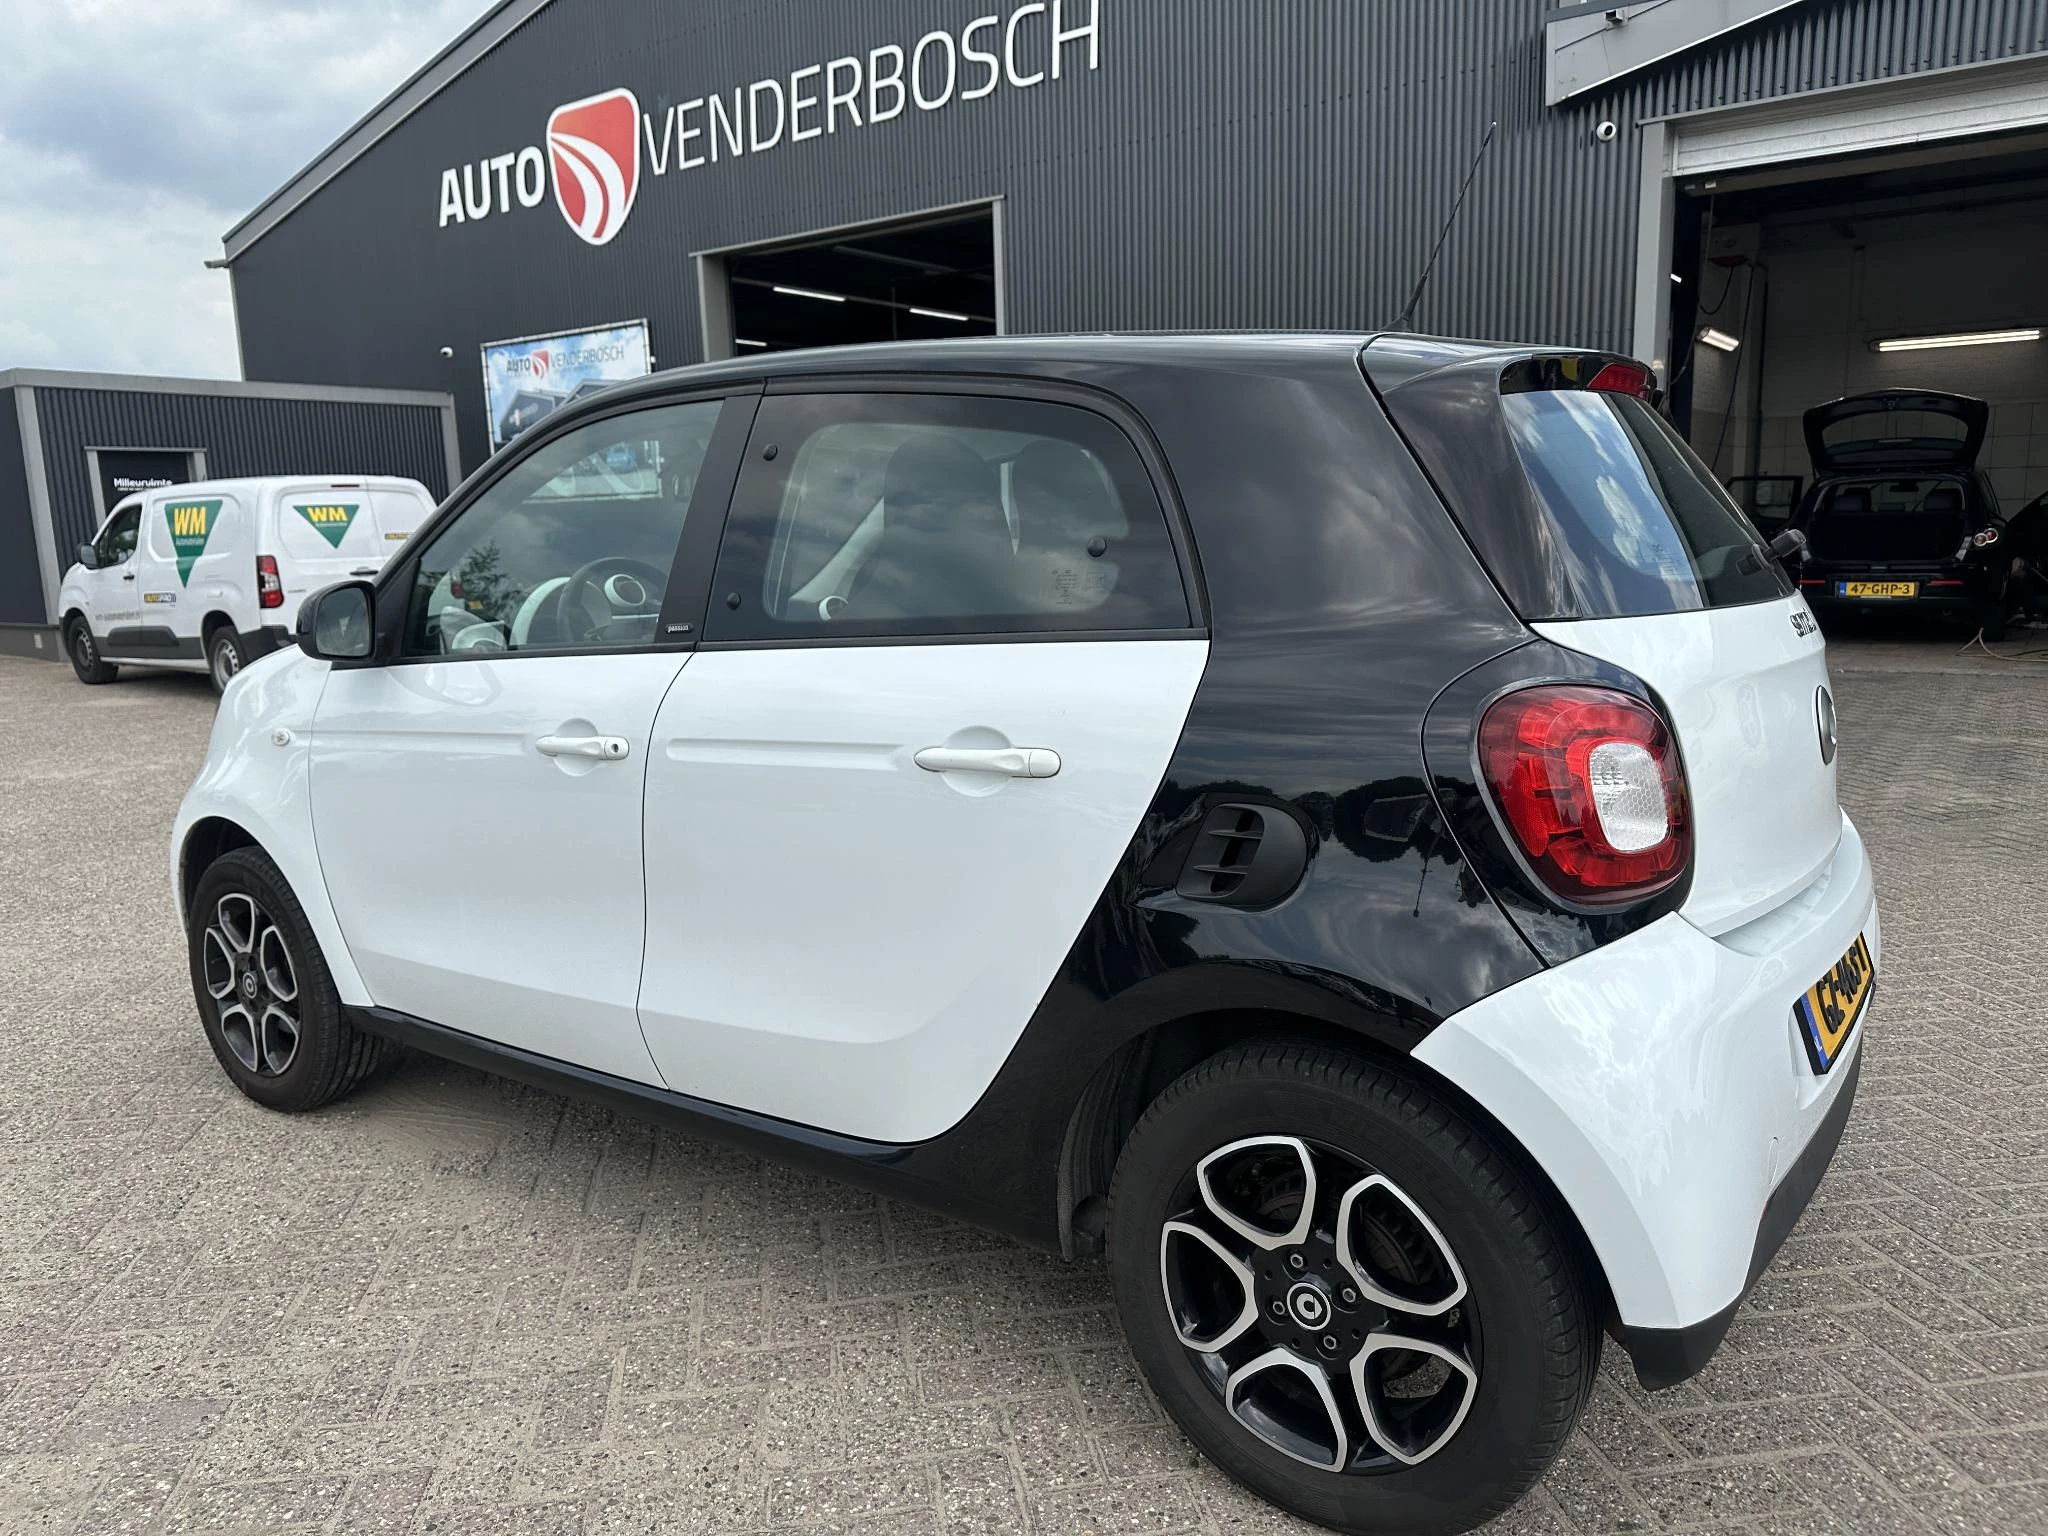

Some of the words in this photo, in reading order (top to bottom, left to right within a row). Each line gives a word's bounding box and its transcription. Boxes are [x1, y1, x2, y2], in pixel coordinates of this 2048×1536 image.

[438, 147, 545, 228] AUTO
[643, 0, 1100, 175] VENDERBOSCH
[506, 357, 531, 373] AUTO
[551, 345, 625, 368] VENDERBOSCH
[174, 506, 206, 536] WM
[306, 506, 348, 522] WM
[1850, 583, 1911, 595] 47-GHP-3
